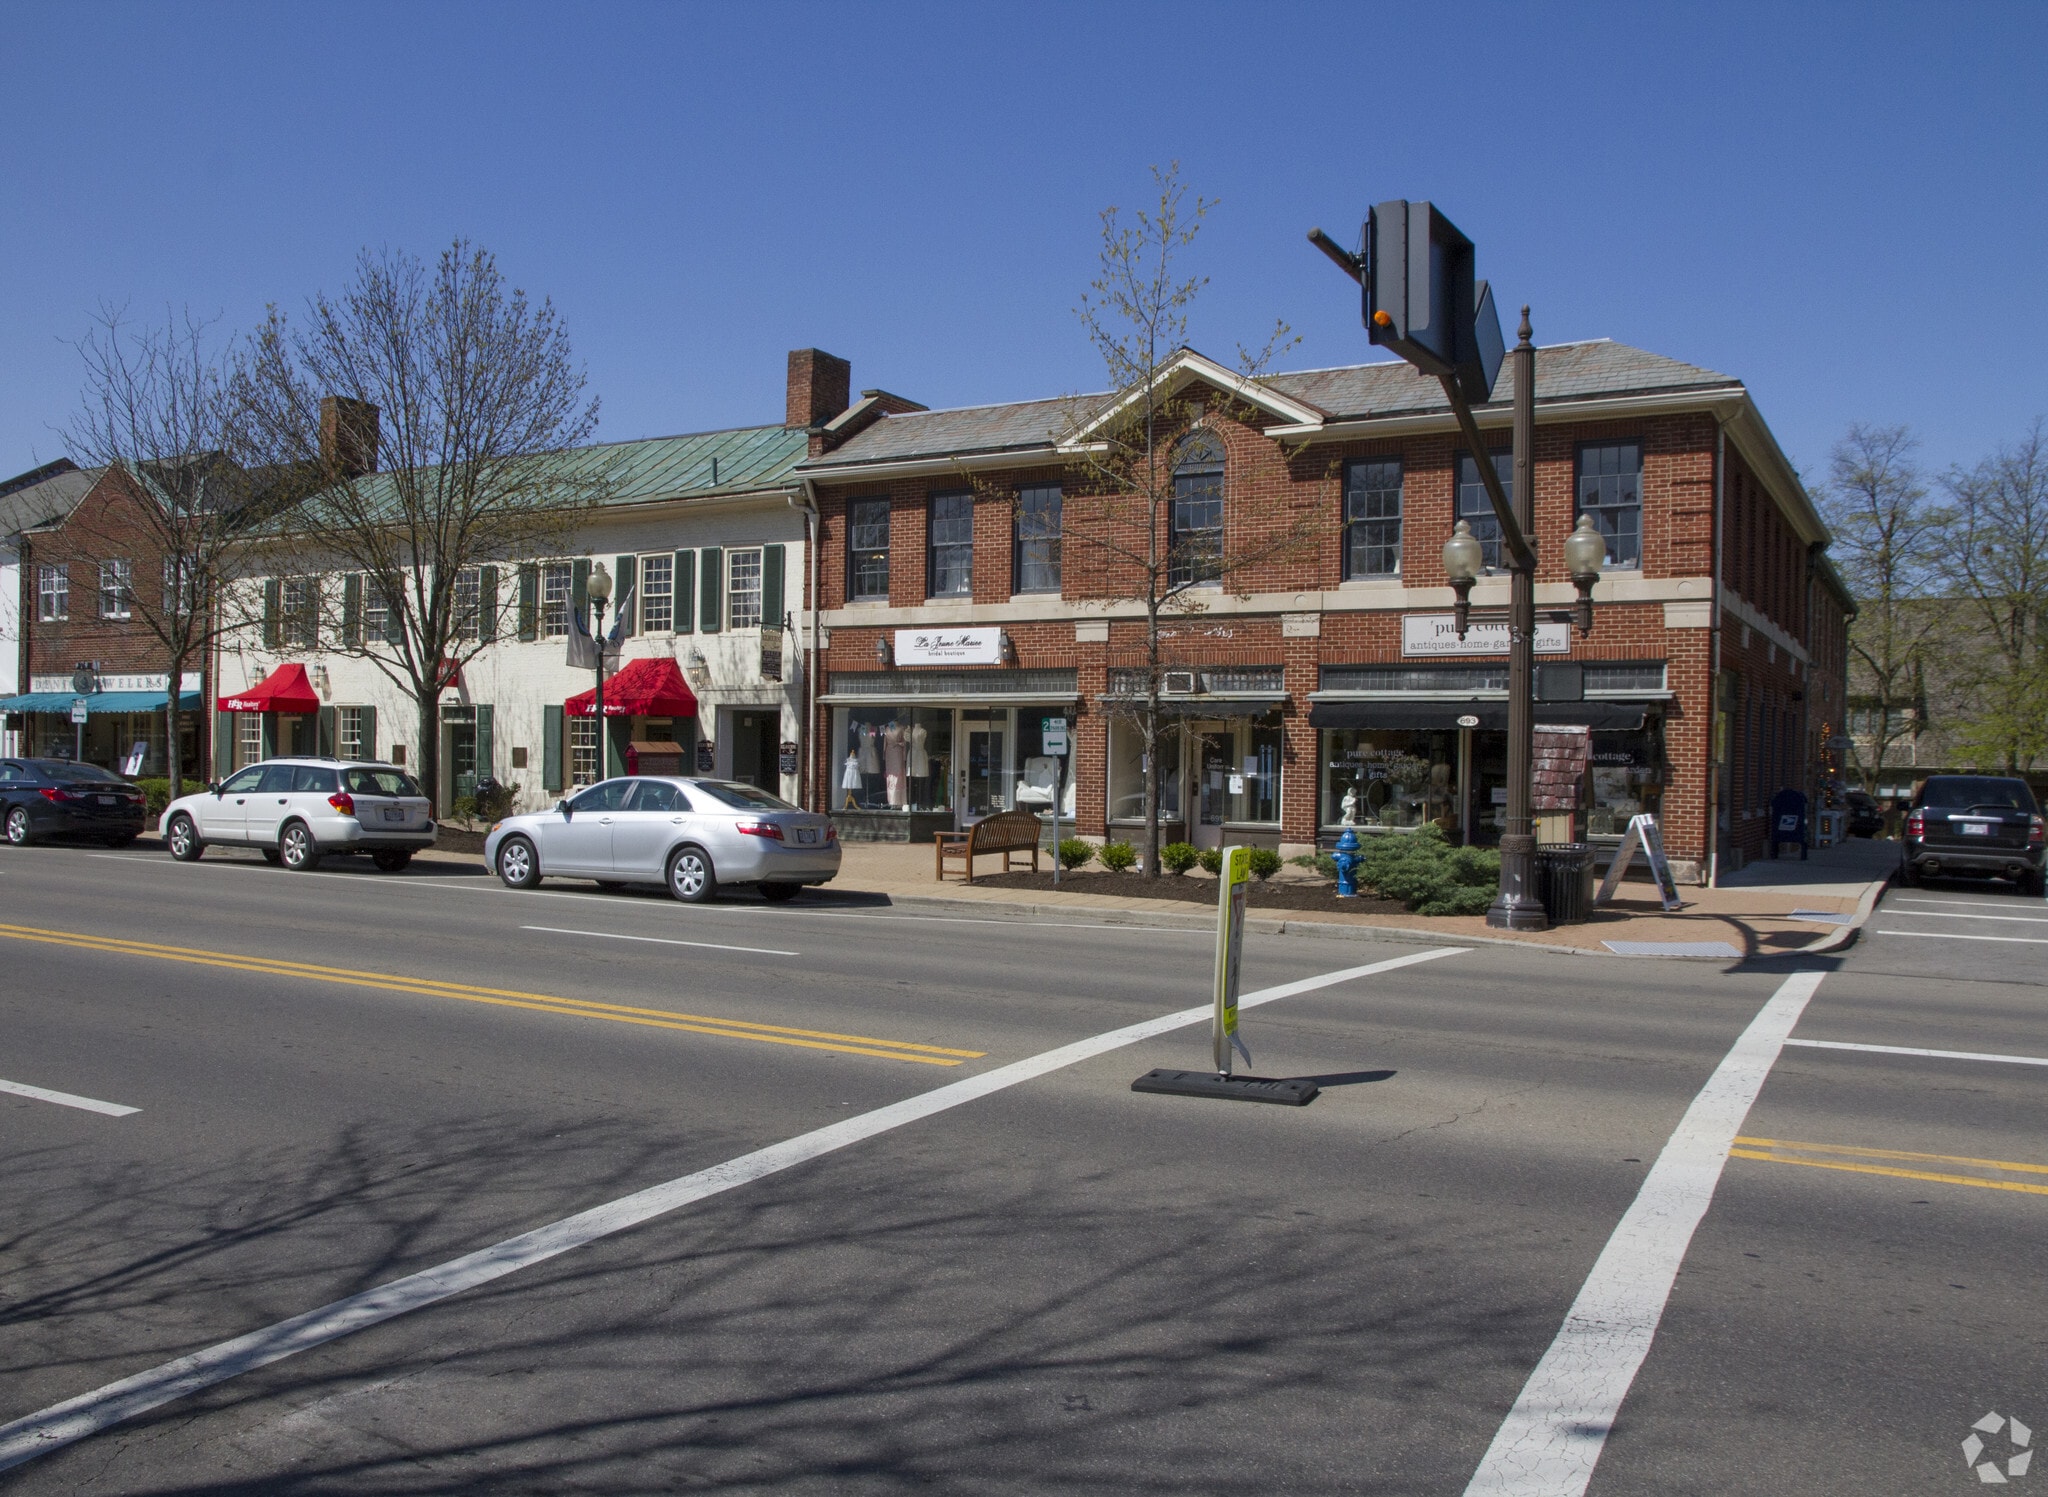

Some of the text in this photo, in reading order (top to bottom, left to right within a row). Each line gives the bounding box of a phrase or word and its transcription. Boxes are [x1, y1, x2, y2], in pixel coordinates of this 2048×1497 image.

[914, 636, 929, 648] La
[1410, 639, 1456, 650] antiques
[1461, 640, 1488, 649] home
[1536, 638, 1561, 648] gifts
[1043, 721, 1050, 732] 2
[1459, 717, 1476, 725] 693
[1593, 752, 1634, 764] cottage
